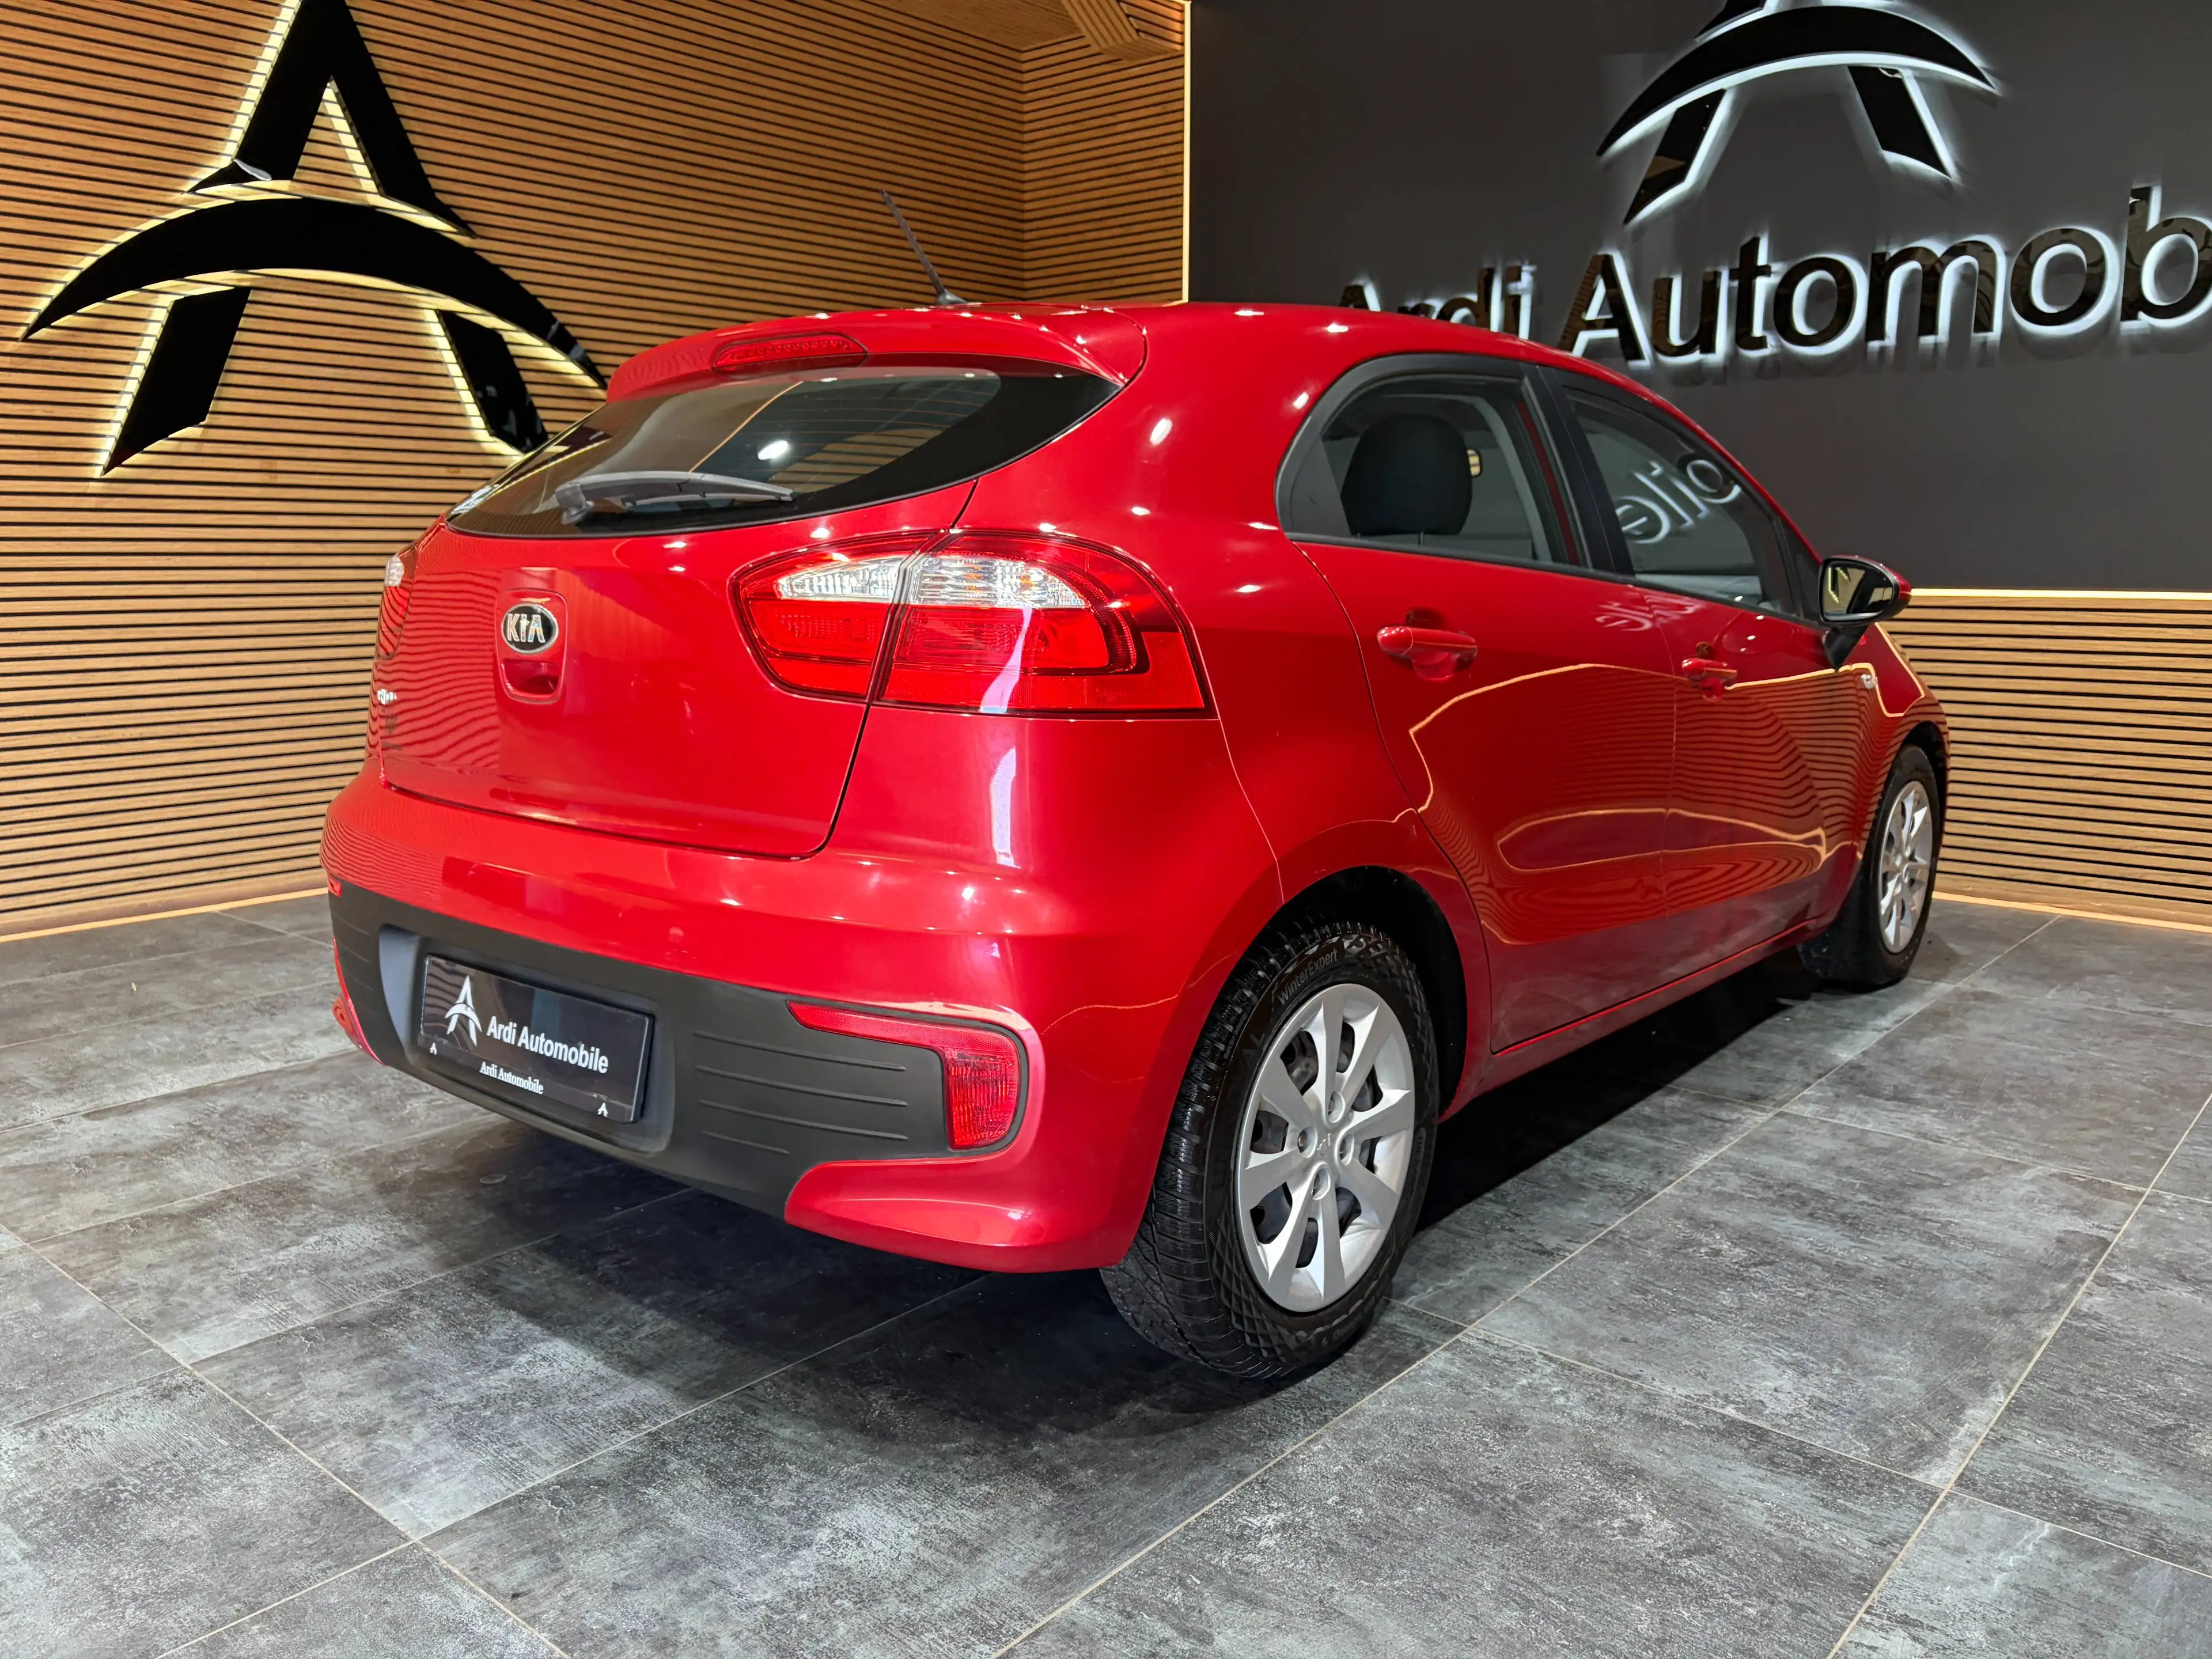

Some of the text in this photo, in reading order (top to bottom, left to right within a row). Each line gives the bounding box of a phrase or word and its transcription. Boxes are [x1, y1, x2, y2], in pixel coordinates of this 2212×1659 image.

[1339, 185, 2212, 369] di Automob
[507, 613, 546, 643] KIA
[486, 1016, 609, 1074] Ardi Automobile
[479, 1061, 544, 1094] Ardi Automobile
